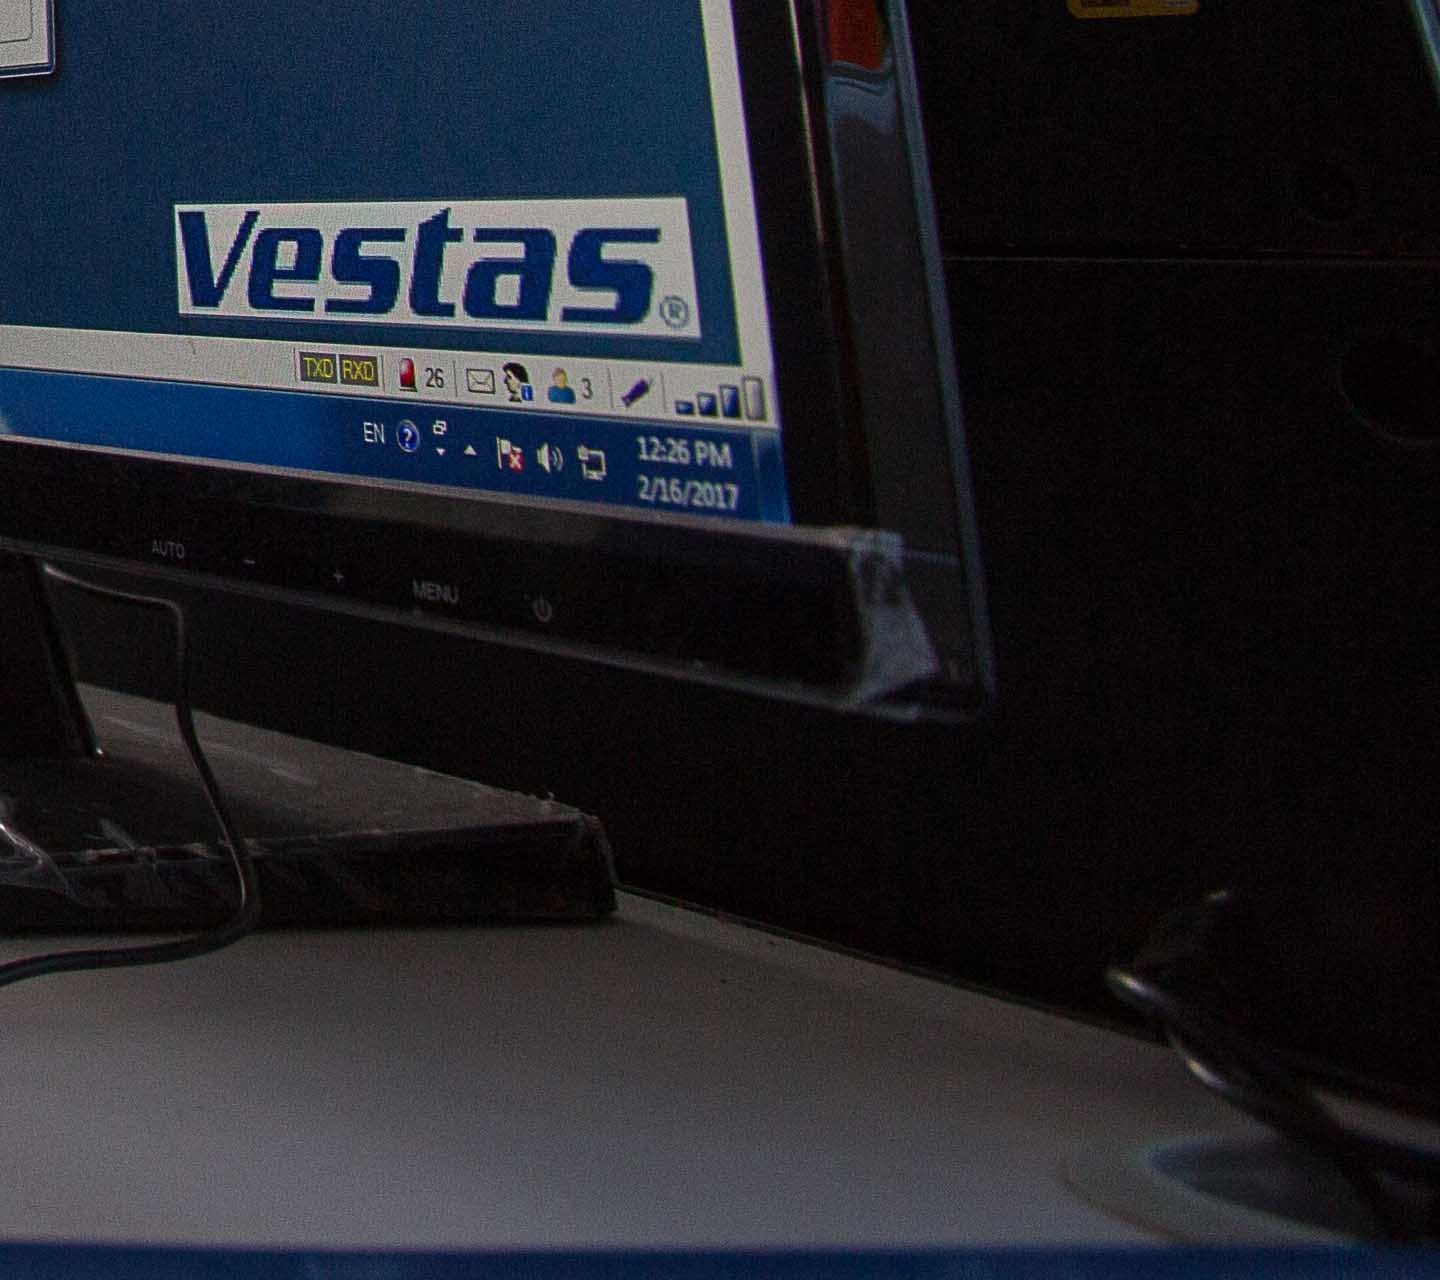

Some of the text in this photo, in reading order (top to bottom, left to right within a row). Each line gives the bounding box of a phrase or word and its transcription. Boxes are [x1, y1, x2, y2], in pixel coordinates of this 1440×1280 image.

[178, 206, 662, 326] Vestas
[303, 354, 593, 400] TXD RXD 26 3
[363, 421, 385, 445] EN
[637, 436, 733, 470] 12:26 PM
[638, 476, 740, 510] 2/16/2017
[150, 540, 186, 561] AUTO
[412, 580, 461, 604] MENU
